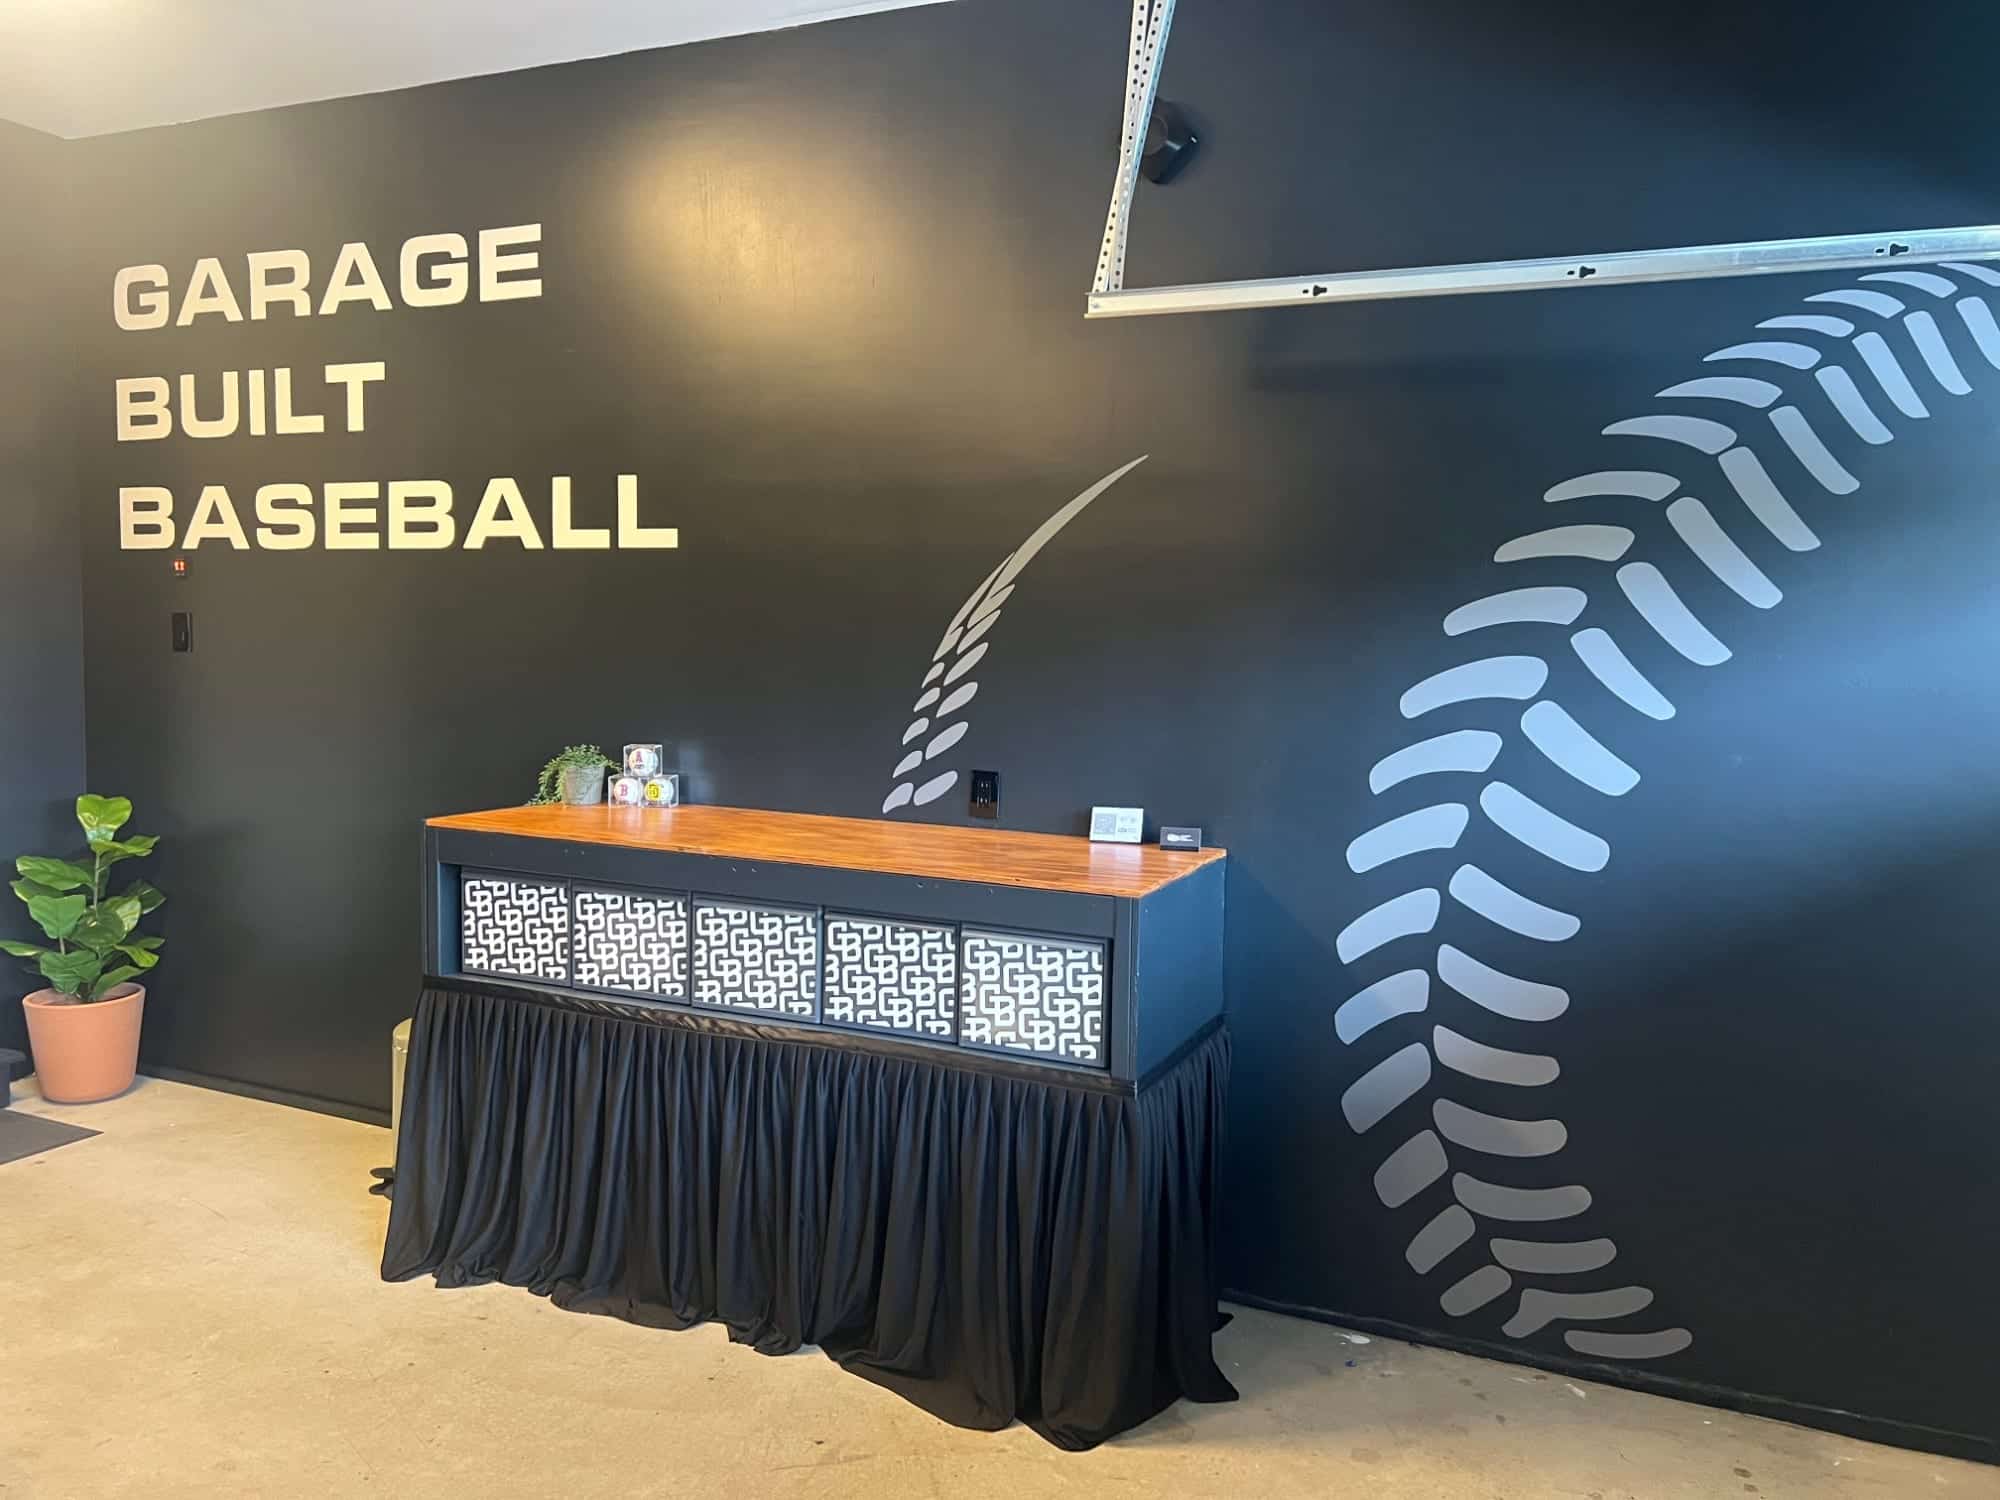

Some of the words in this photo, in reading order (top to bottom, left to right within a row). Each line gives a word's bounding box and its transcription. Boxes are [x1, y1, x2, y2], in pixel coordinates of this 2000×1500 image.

[113, 223, 543, 331] GARAGE
[115, 361, 386, 441] BUILT
[119, 474, 679, 550] BASEBALL
